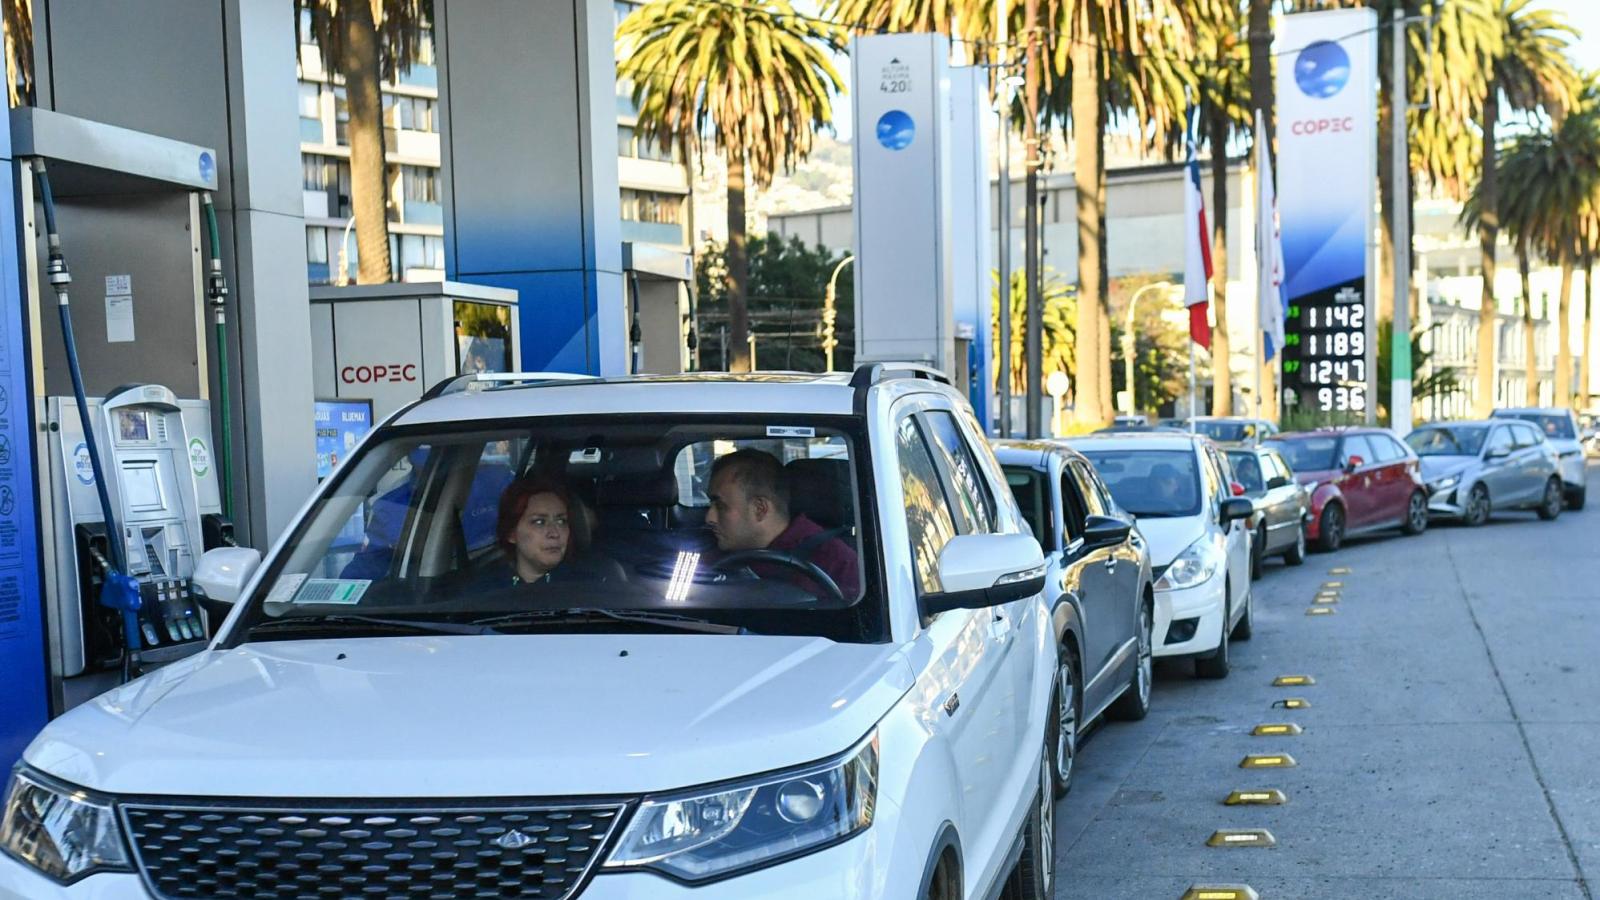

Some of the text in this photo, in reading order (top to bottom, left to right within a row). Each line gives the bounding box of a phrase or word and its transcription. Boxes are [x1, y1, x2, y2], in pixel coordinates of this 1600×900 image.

[880, 80, 907, 93] 4.20
[1292, 116, 1353, 136] COPEC
[1309, 303, 1365, 329] 1142
[1309, 331, 1365, 356] 1189
[341, 364, 416, 384] COPEC
[1283, 359, 1365, 384] 97 1247
[1318, 387, 1365, 411] 936
